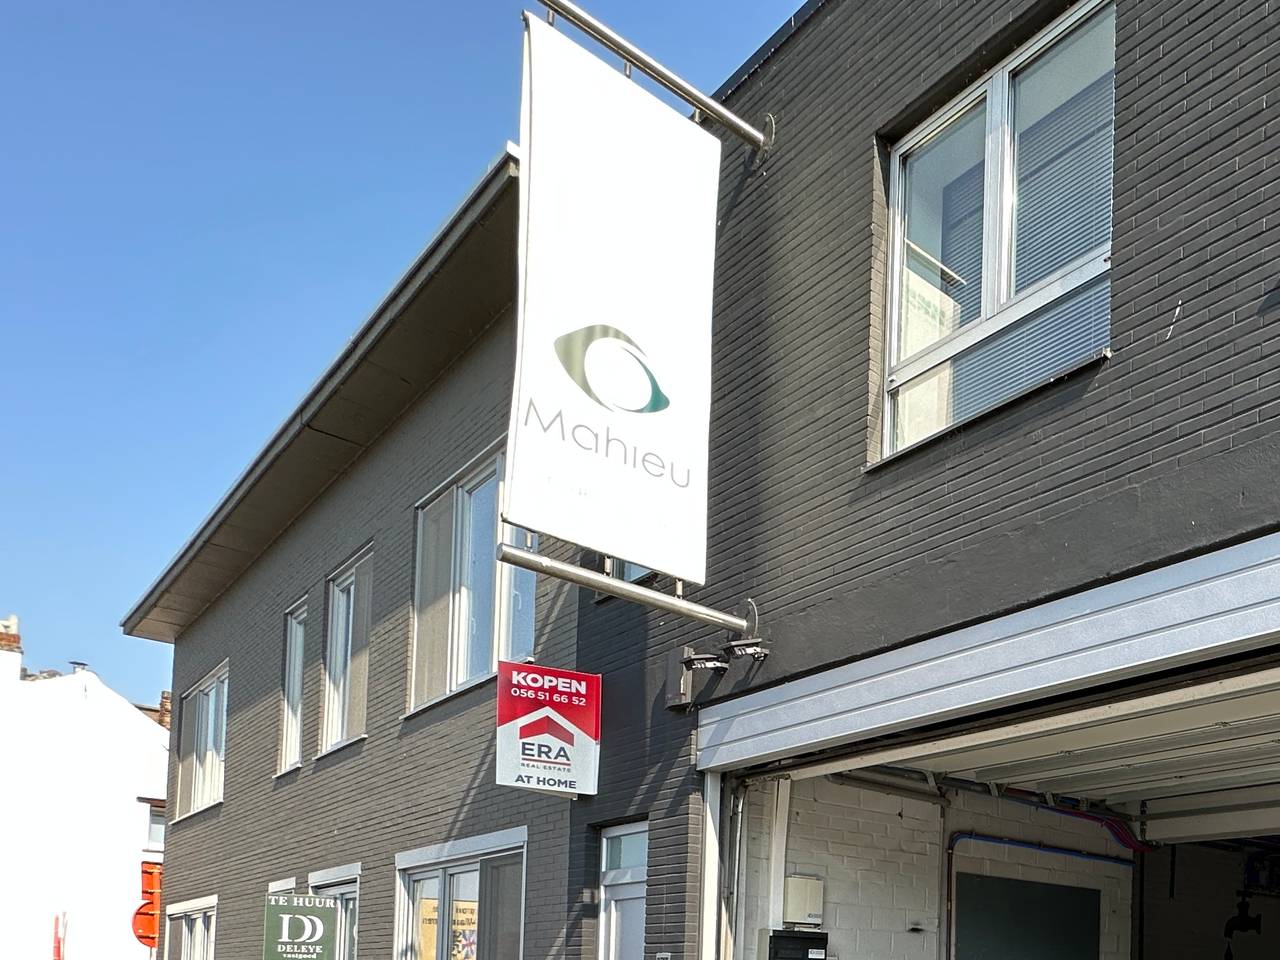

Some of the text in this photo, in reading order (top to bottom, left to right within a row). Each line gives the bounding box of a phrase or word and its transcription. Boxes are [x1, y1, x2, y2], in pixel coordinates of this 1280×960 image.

[523, 397, 690, 489] Mahieu
[511, 670, 587, 695] KOPEN
[510, 687, 586, 706] 056 51 66 52
[521, 741, 571, 761] ERA
[520, 762, 572, 773] REAL ESTATE
[514, 774, 577, 789] AT HOME
[268, 896, 336, 908] TE HUUR
[277, 944, 323, 953] DELEYE
